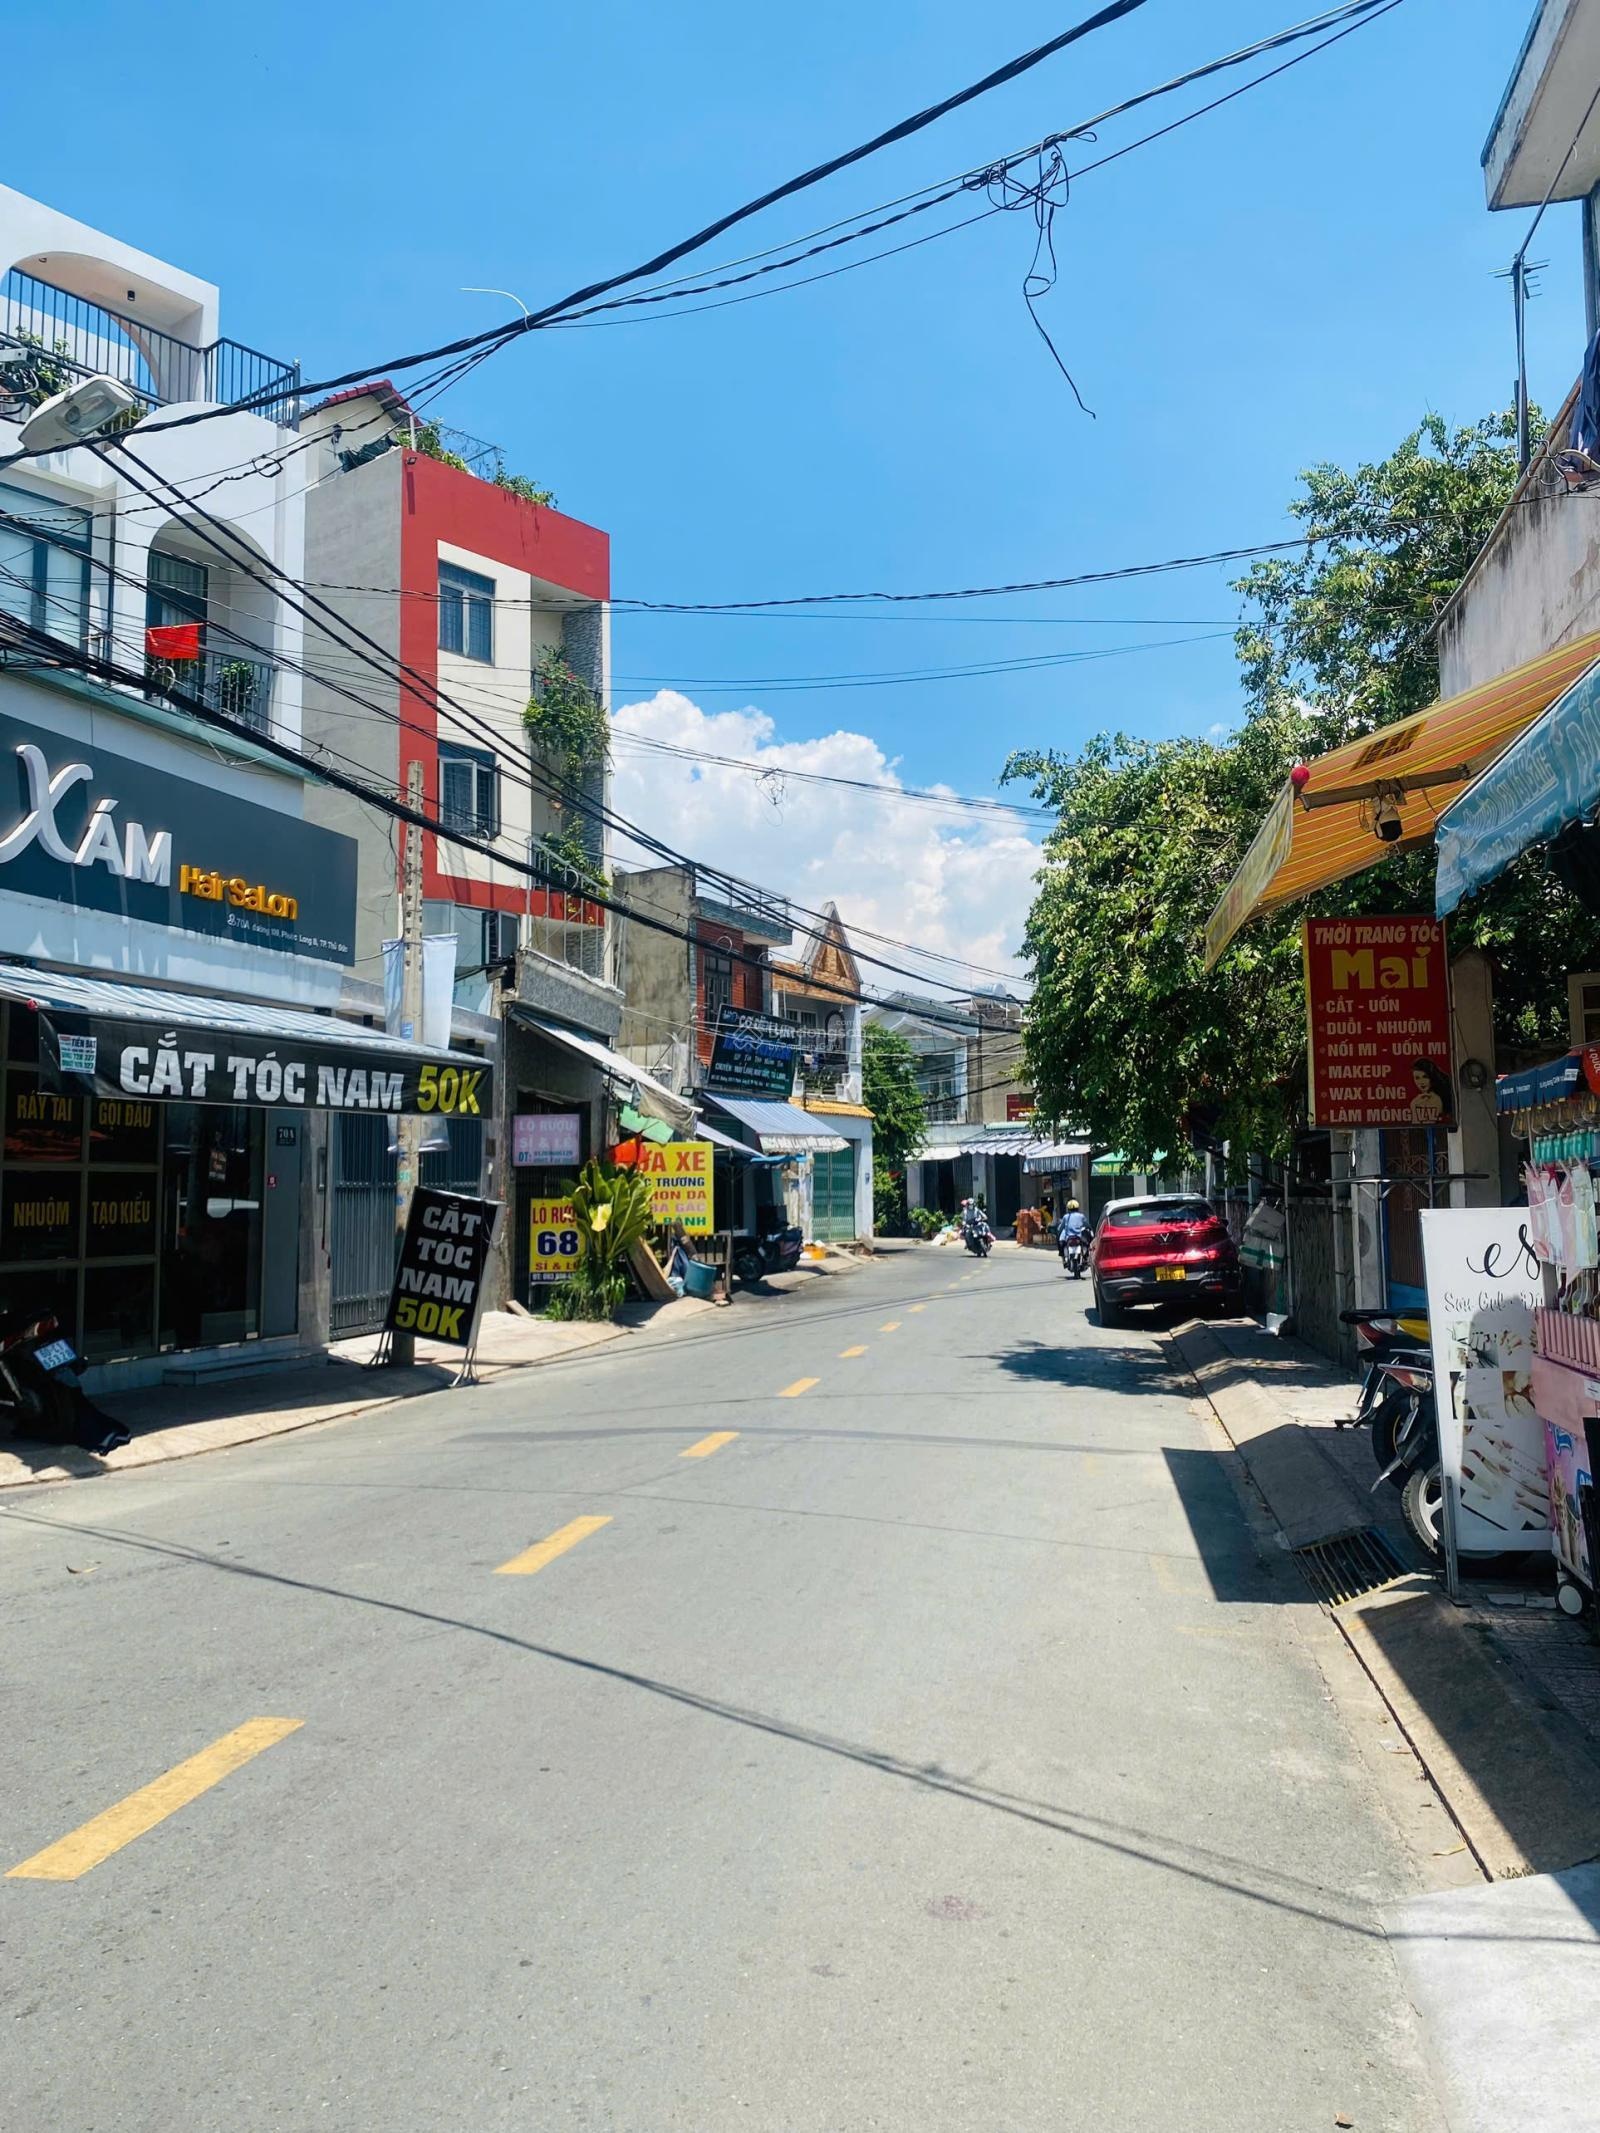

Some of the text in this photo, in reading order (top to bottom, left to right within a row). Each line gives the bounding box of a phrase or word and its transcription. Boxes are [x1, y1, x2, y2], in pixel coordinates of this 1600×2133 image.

[0, 745, 172, 887] XÁM
[180, 865, 226, 901] Hair
[1315, 920, 1440, 945] THỜI TRANG TÓC
[1331, 946, 1431, 990] Mai
[1368, 994, 1400, 1012] UỐN
[1376, 1017, 1432, 1037] NHUỘM
[1327, 1038, 1353, 1057] NỐI
[1358, 1043, 1377, 1056] MI
[1392, 1037, 1423, 1056] UỐN
[1428, 1042, 1447, 1055] MI
[120, 1031, 481, 1114] CẮT TÓC NAM 50K
[1328, 1065, 1392, 1079] MAKEUP
[1329, 1084, 1407, 1100] WAX LÔNG
[52, 1097, 73, 1122] TAI
[1330, 1106, 1362, 1122] LÀM
[1367, 1106, 1411, 1122] MÓNG
[676, 1151, 706, 1172] XE
[686, 1190, 706, 1201] DA
[14, 1195, 70, 1232] NHUỘM
[92, 1191, 151, 1230] TẠO KIỂU
[422, 1202, 482, 1237] CẮT
[416, 1237, 473, 1270] TÓC
[537, 1230, 579, 1256] 68
[398, 1267, 475, 1304] NAM
[395, 1296, 465, 1339] 50K
